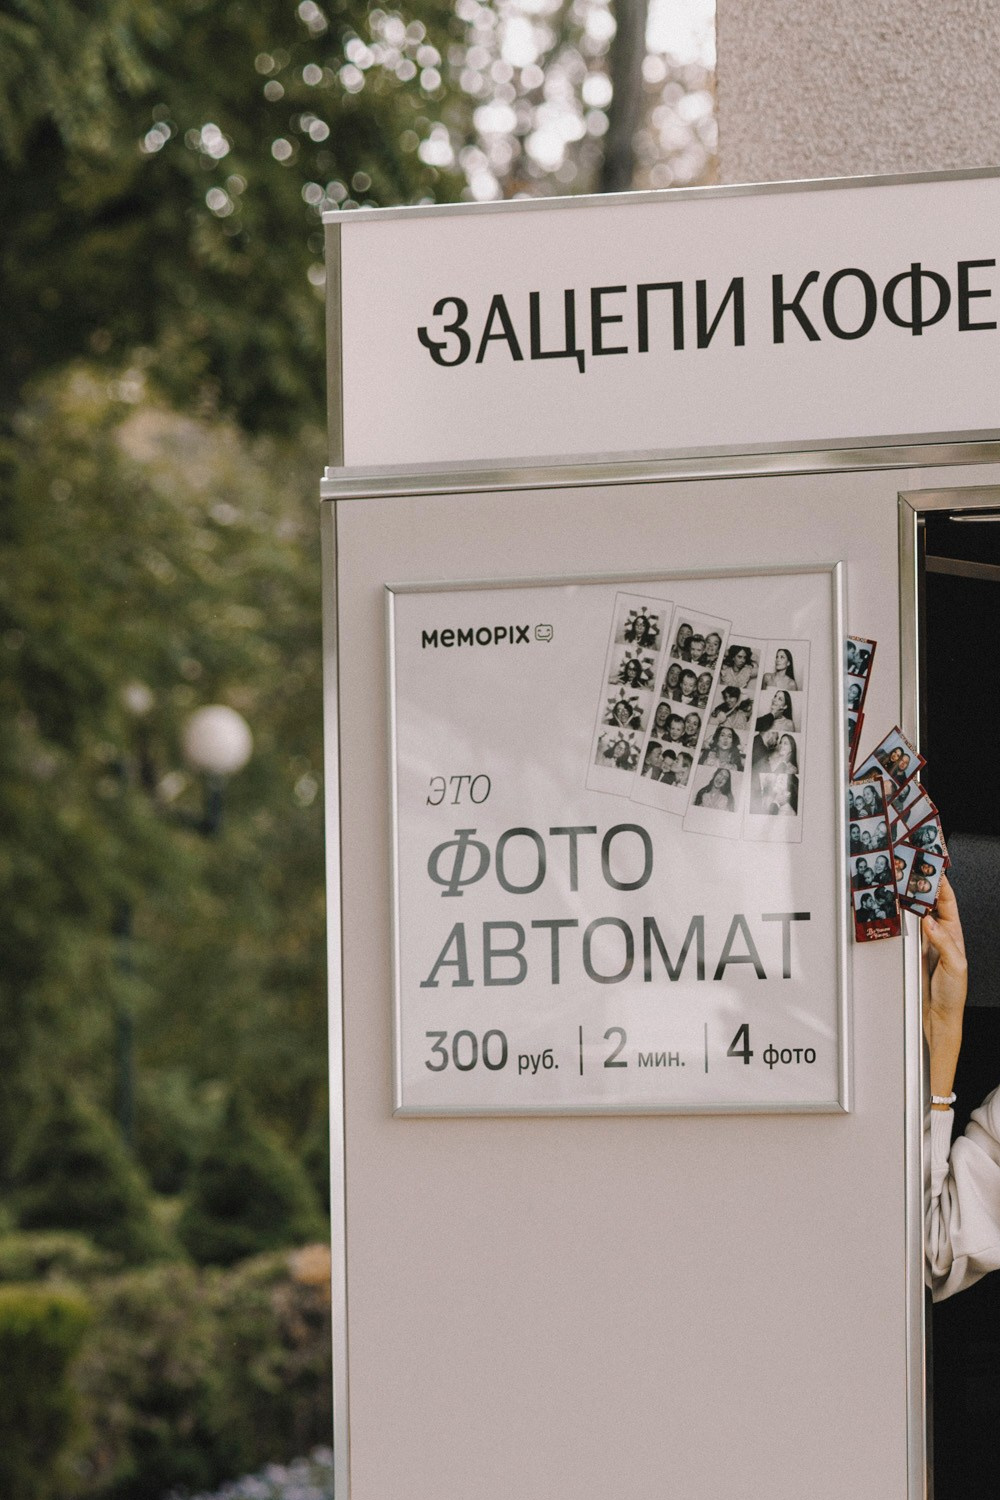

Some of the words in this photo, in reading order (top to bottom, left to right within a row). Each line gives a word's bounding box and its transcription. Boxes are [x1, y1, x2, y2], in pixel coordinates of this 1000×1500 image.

[417, 277, 746, 374] ЗАЦЕПИ
[772, 259, 998, 345] КОФЕ
[425, 773, 492, 807] ЭТО
[426, 823, 654, 898] ФОТО
[420, 911, 812, 989] АВТОМАТ
[424, 1029, 509, 1073] 300
[517, 1048, 560, 1075] руб.
[602, 1026, 629, 1069] 2
[637, 1049, 686, 1068] мин.
[726, 1023, 755, 1066] 4
[762, 1043, 817, 1070] фото
